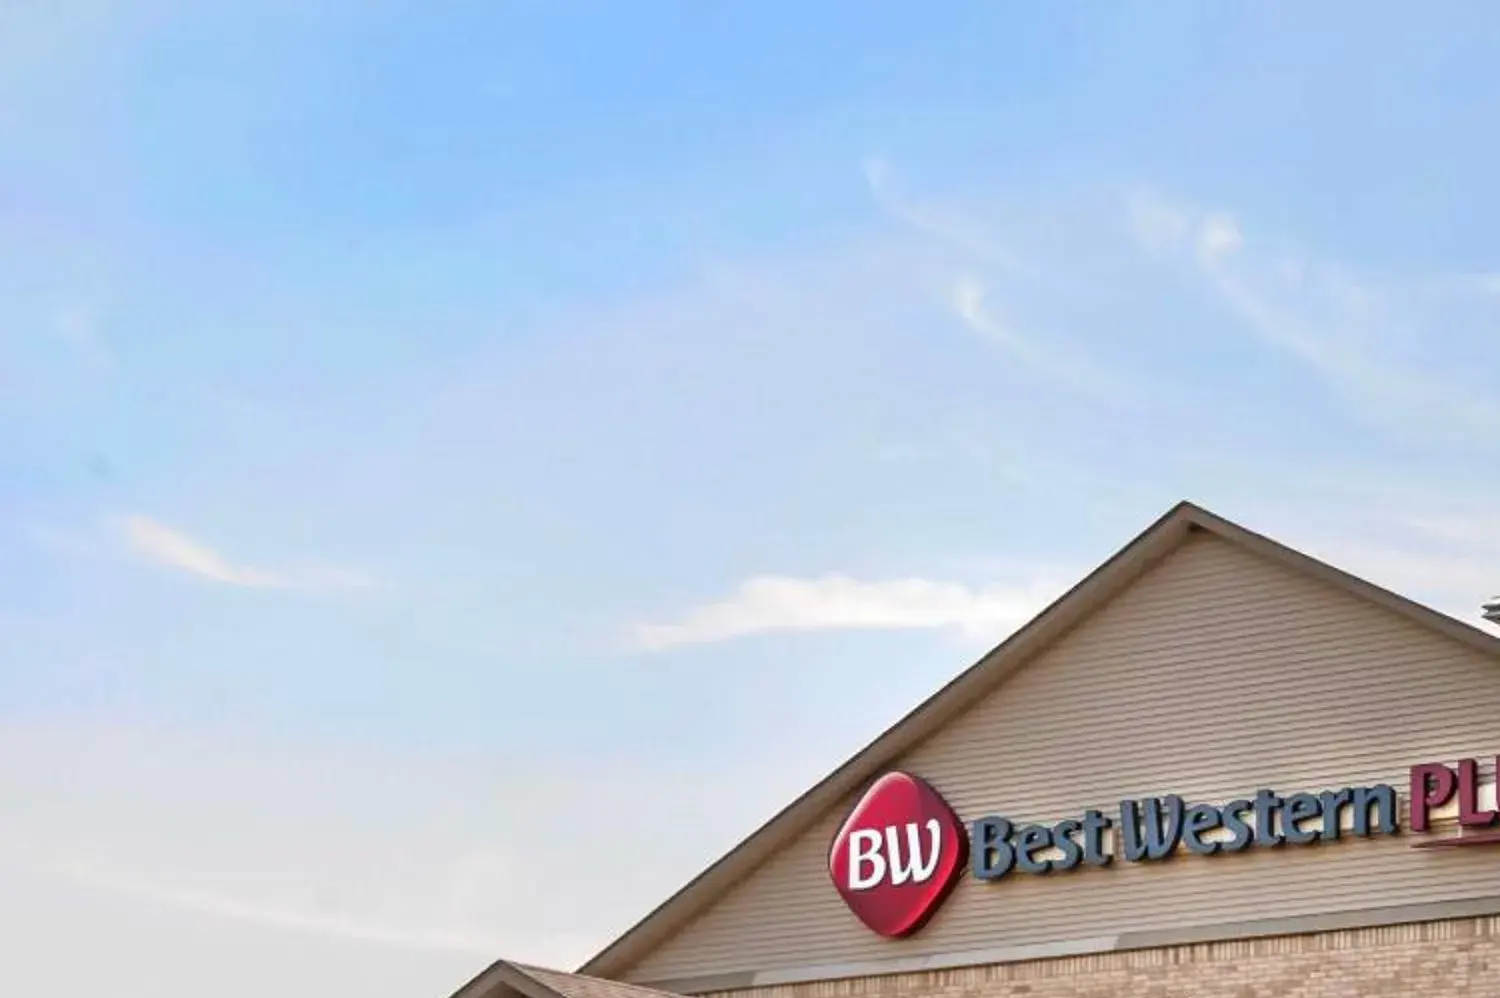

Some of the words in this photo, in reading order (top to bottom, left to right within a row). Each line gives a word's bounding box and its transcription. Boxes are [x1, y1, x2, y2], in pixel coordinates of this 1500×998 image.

[848, 818, 942, 891] BW
[971, 809, 1113, 881] Best
[1119, 783, 1398, 862] Western
